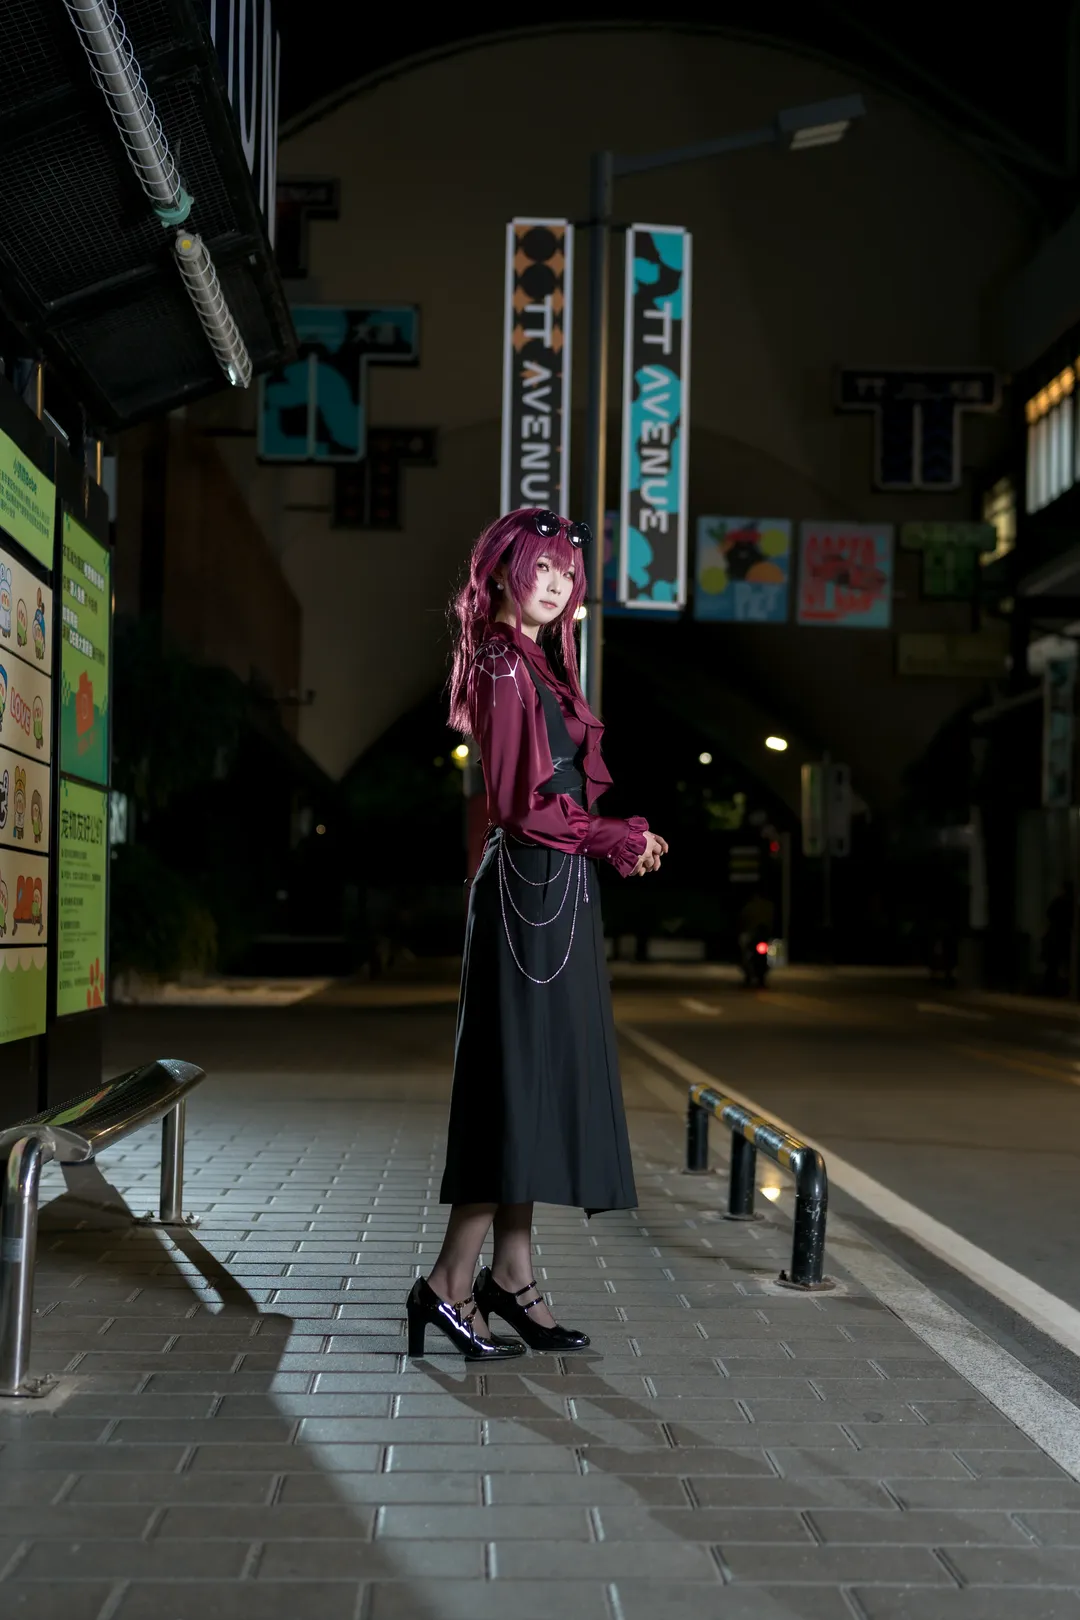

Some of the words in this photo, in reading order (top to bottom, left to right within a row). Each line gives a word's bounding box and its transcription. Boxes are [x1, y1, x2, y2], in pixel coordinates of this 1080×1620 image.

[524, 295, 553, 348] TT
[643, 301, 673, 355] TT
[519, 360, 552, 510] AVENU
[638, 365, 671, 534] AVENUE
[10, 686, 31, 736] LOVE
[61, 808, 102, 846] 宠物友好公约
